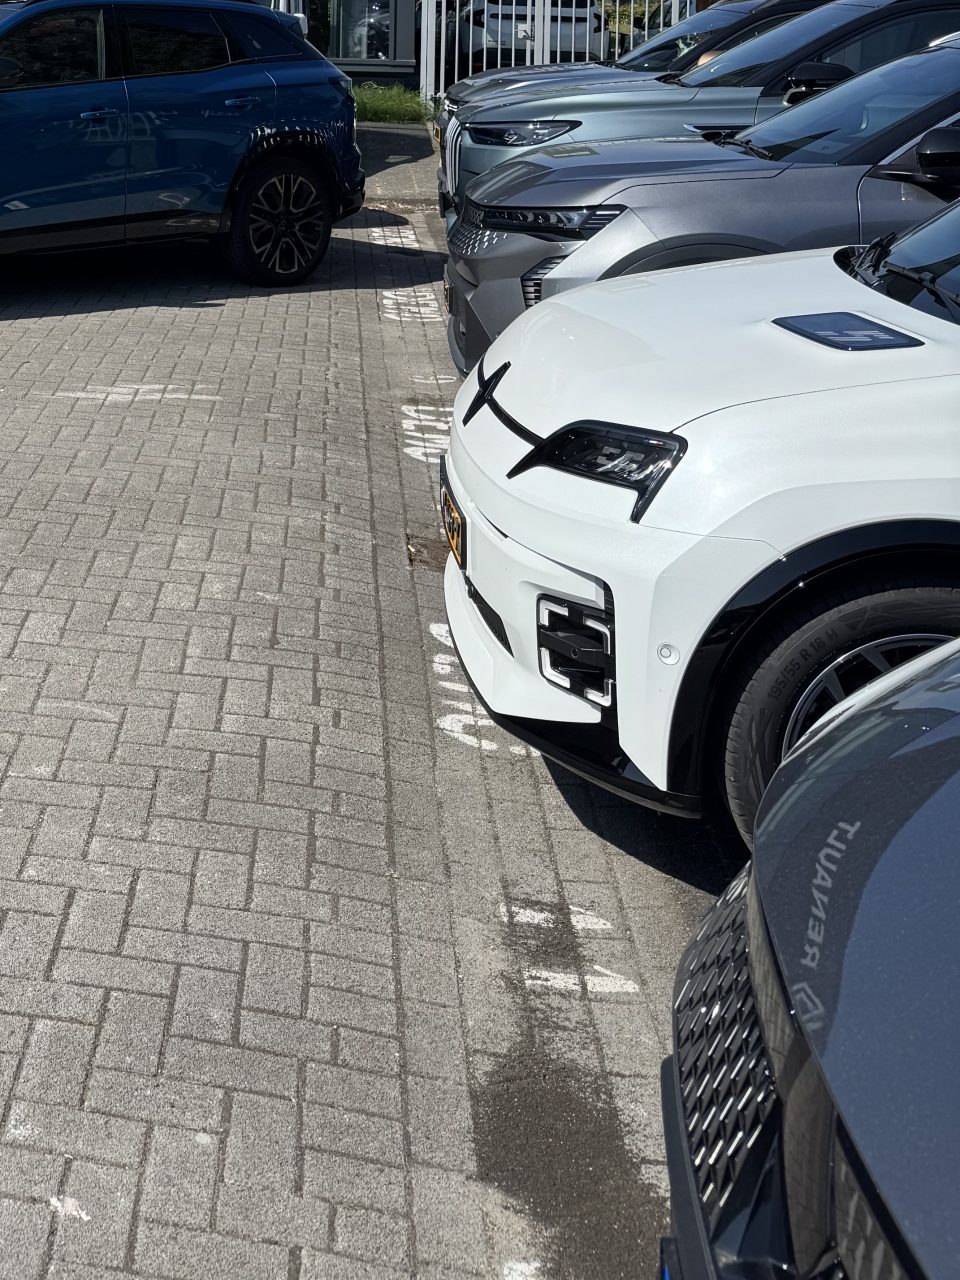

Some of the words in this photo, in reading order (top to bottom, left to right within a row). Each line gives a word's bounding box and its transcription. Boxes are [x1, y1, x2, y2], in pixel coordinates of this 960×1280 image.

[767, 658, 802, 700] 195/55
[798, 648, 813, 661] R
[809, 636, 825, 652] 18
[825, 627, 839, 642] H
